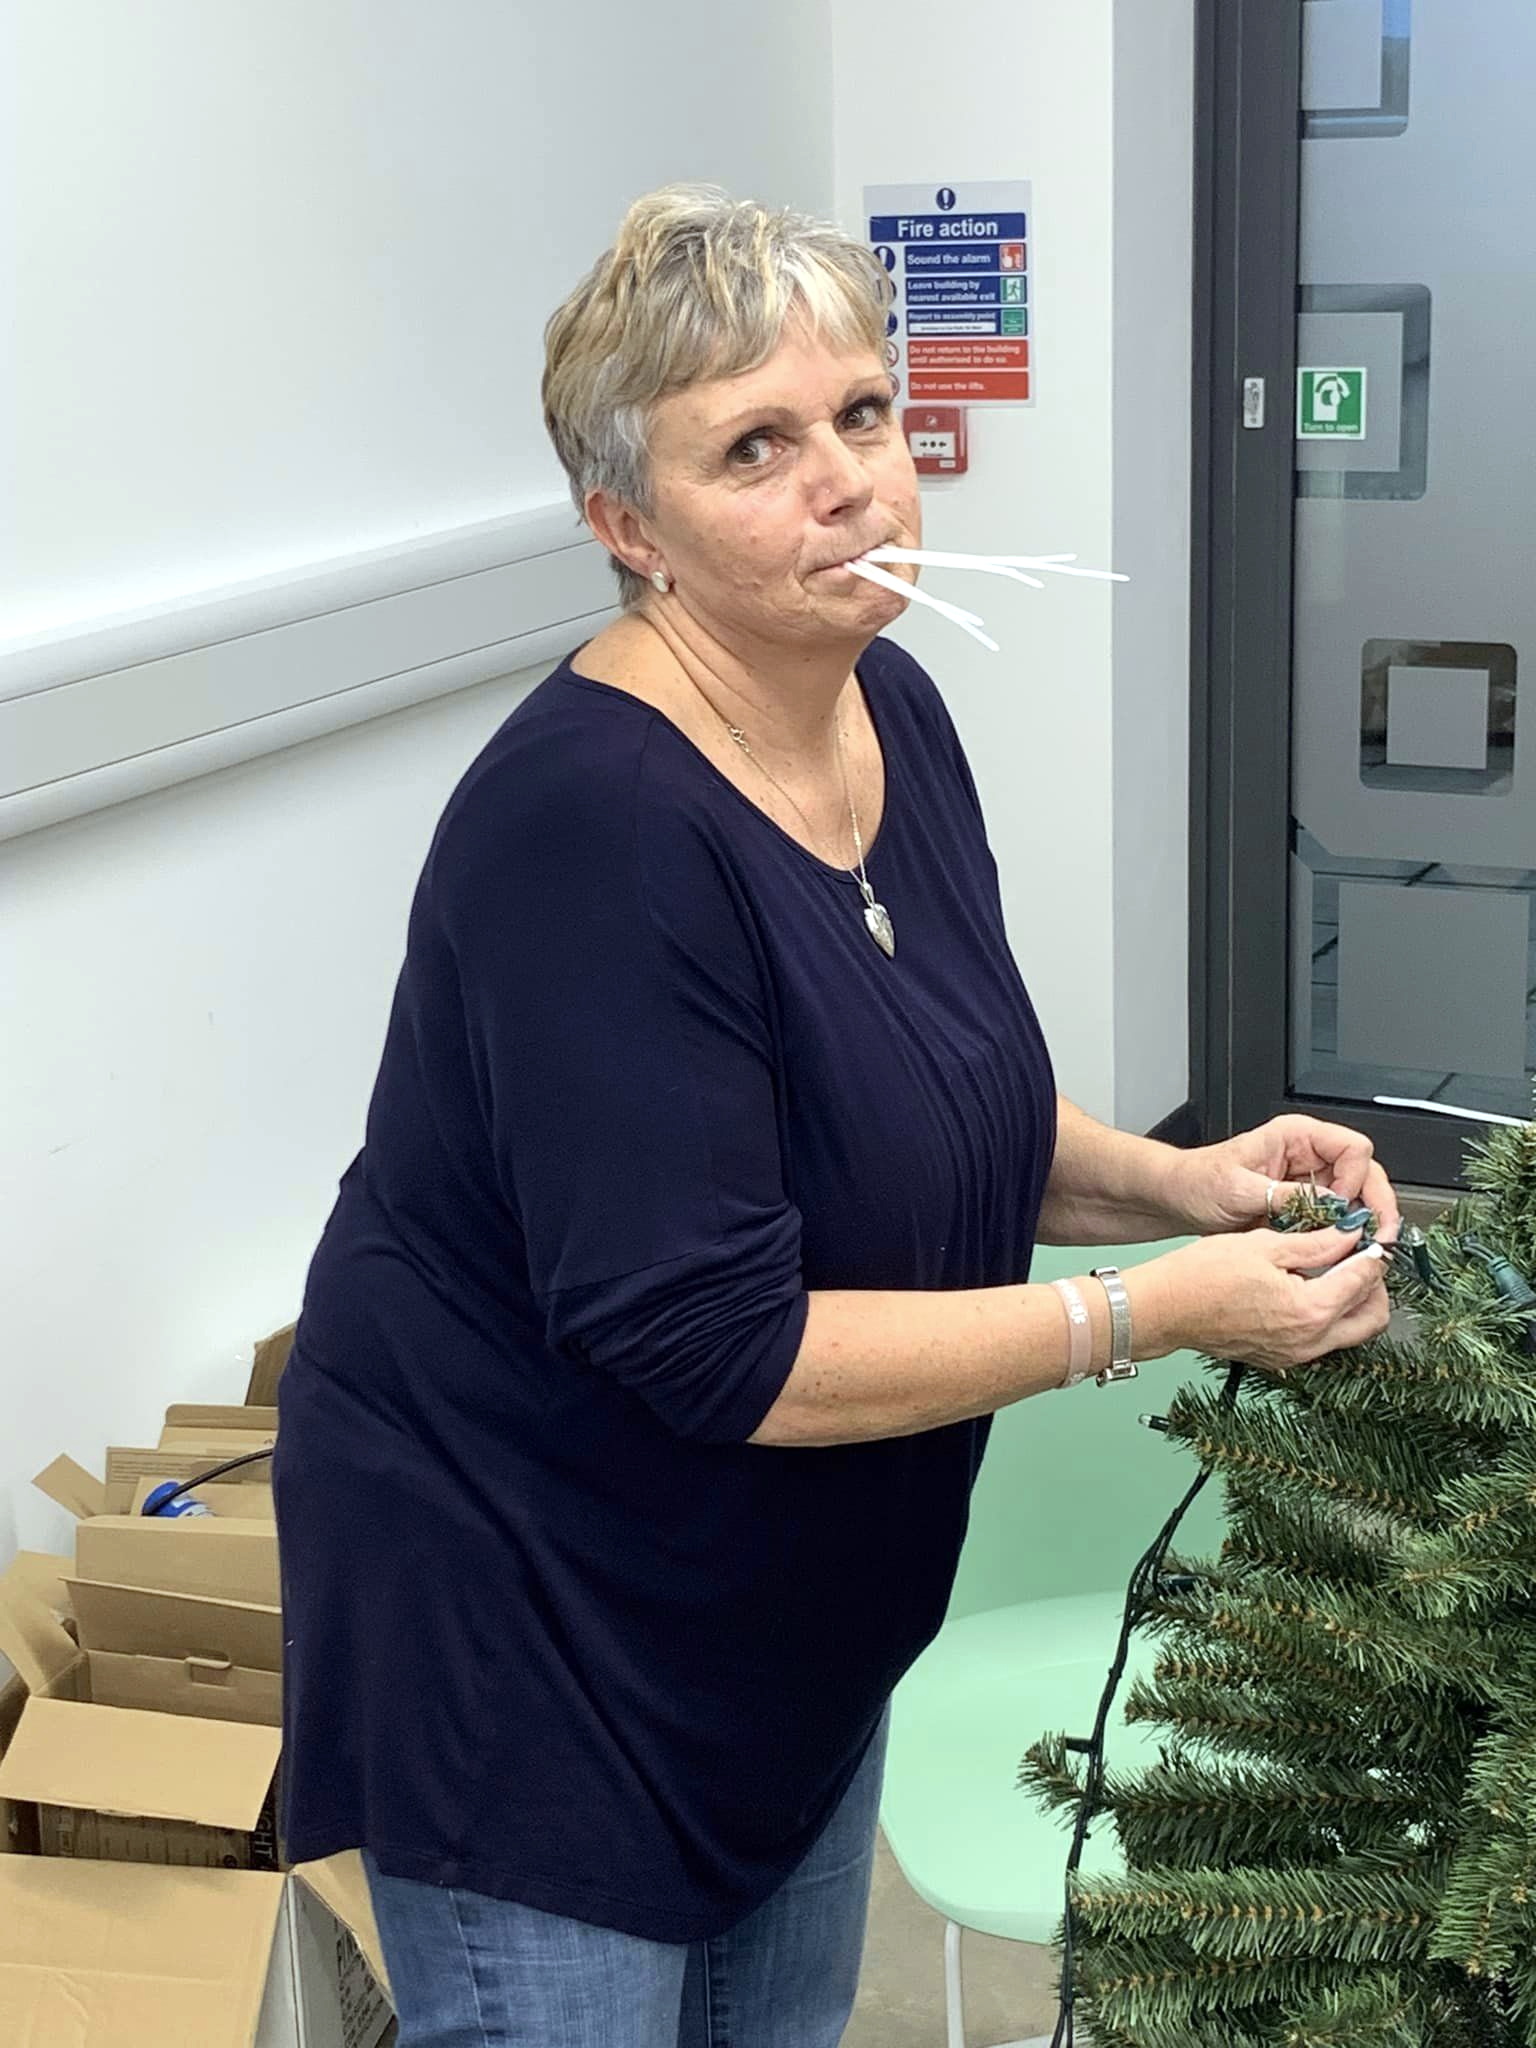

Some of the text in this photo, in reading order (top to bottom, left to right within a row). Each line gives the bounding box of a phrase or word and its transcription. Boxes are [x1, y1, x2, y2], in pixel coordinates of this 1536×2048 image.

[897, 218, 998, 238] Fire action
[907, 253, 991, 265] Sound the alarm
[907, 280, 981, 291] Leave building by
[908, 292, 996, 302] nearest available exit
[908, 312, 996, 321] Report to assembly point
[909, 344, 1021, 355] Do not return to the building
[909, 356, 927, 364] until
[929, 355, 971, 364] authorised
[983, 355, 994, 364] do
[911, 382, 922, 390] Do
[923, 382, 937, 390] not
[938, 383, 953, 391] use
[954, 381, 967, 390] the
[1303, 422, 1359, 432] Turn to open
